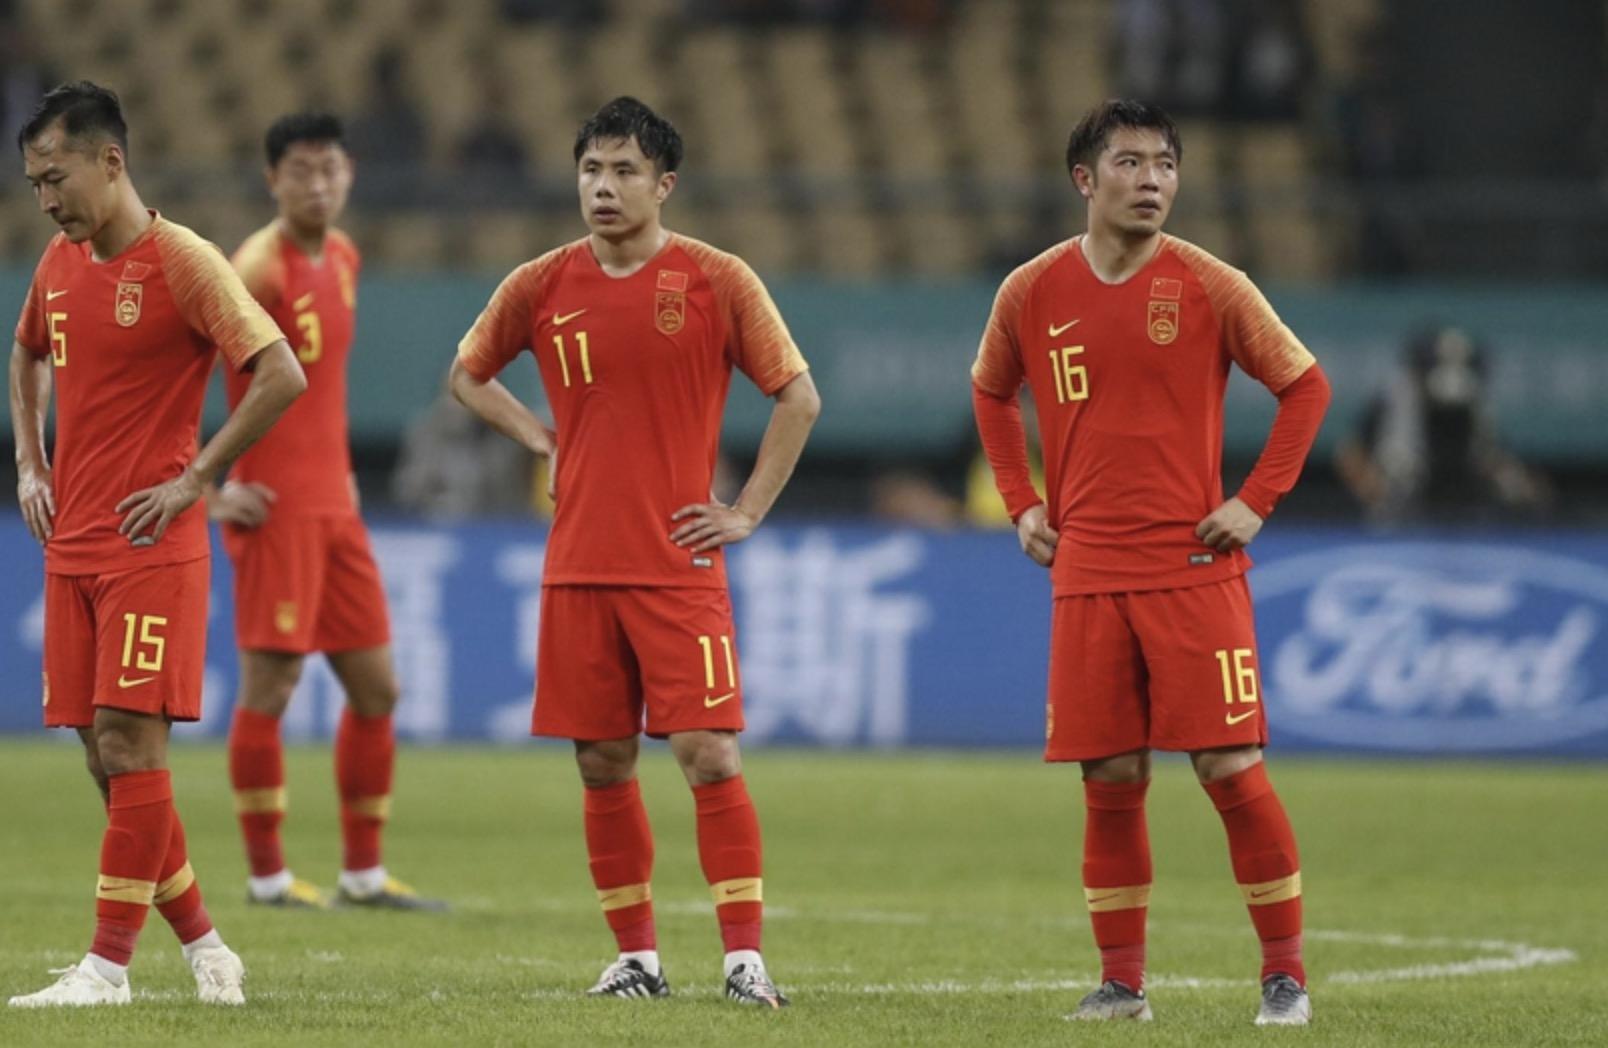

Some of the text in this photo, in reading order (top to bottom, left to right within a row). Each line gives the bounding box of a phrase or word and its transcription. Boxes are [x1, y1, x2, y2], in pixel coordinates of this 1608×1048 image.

[46, 311, 67, 367] 5
[296, 311, 322, 363] 3
[553, 331, 592, 387] 11
[1049, 345, 1088, 404] 16
[121, 613, 167, 672] 15
[698, 635, 735, 689] 11
[1273, 562, 1597, 716] Ford
[1215, 648, 1257, 704] 16
